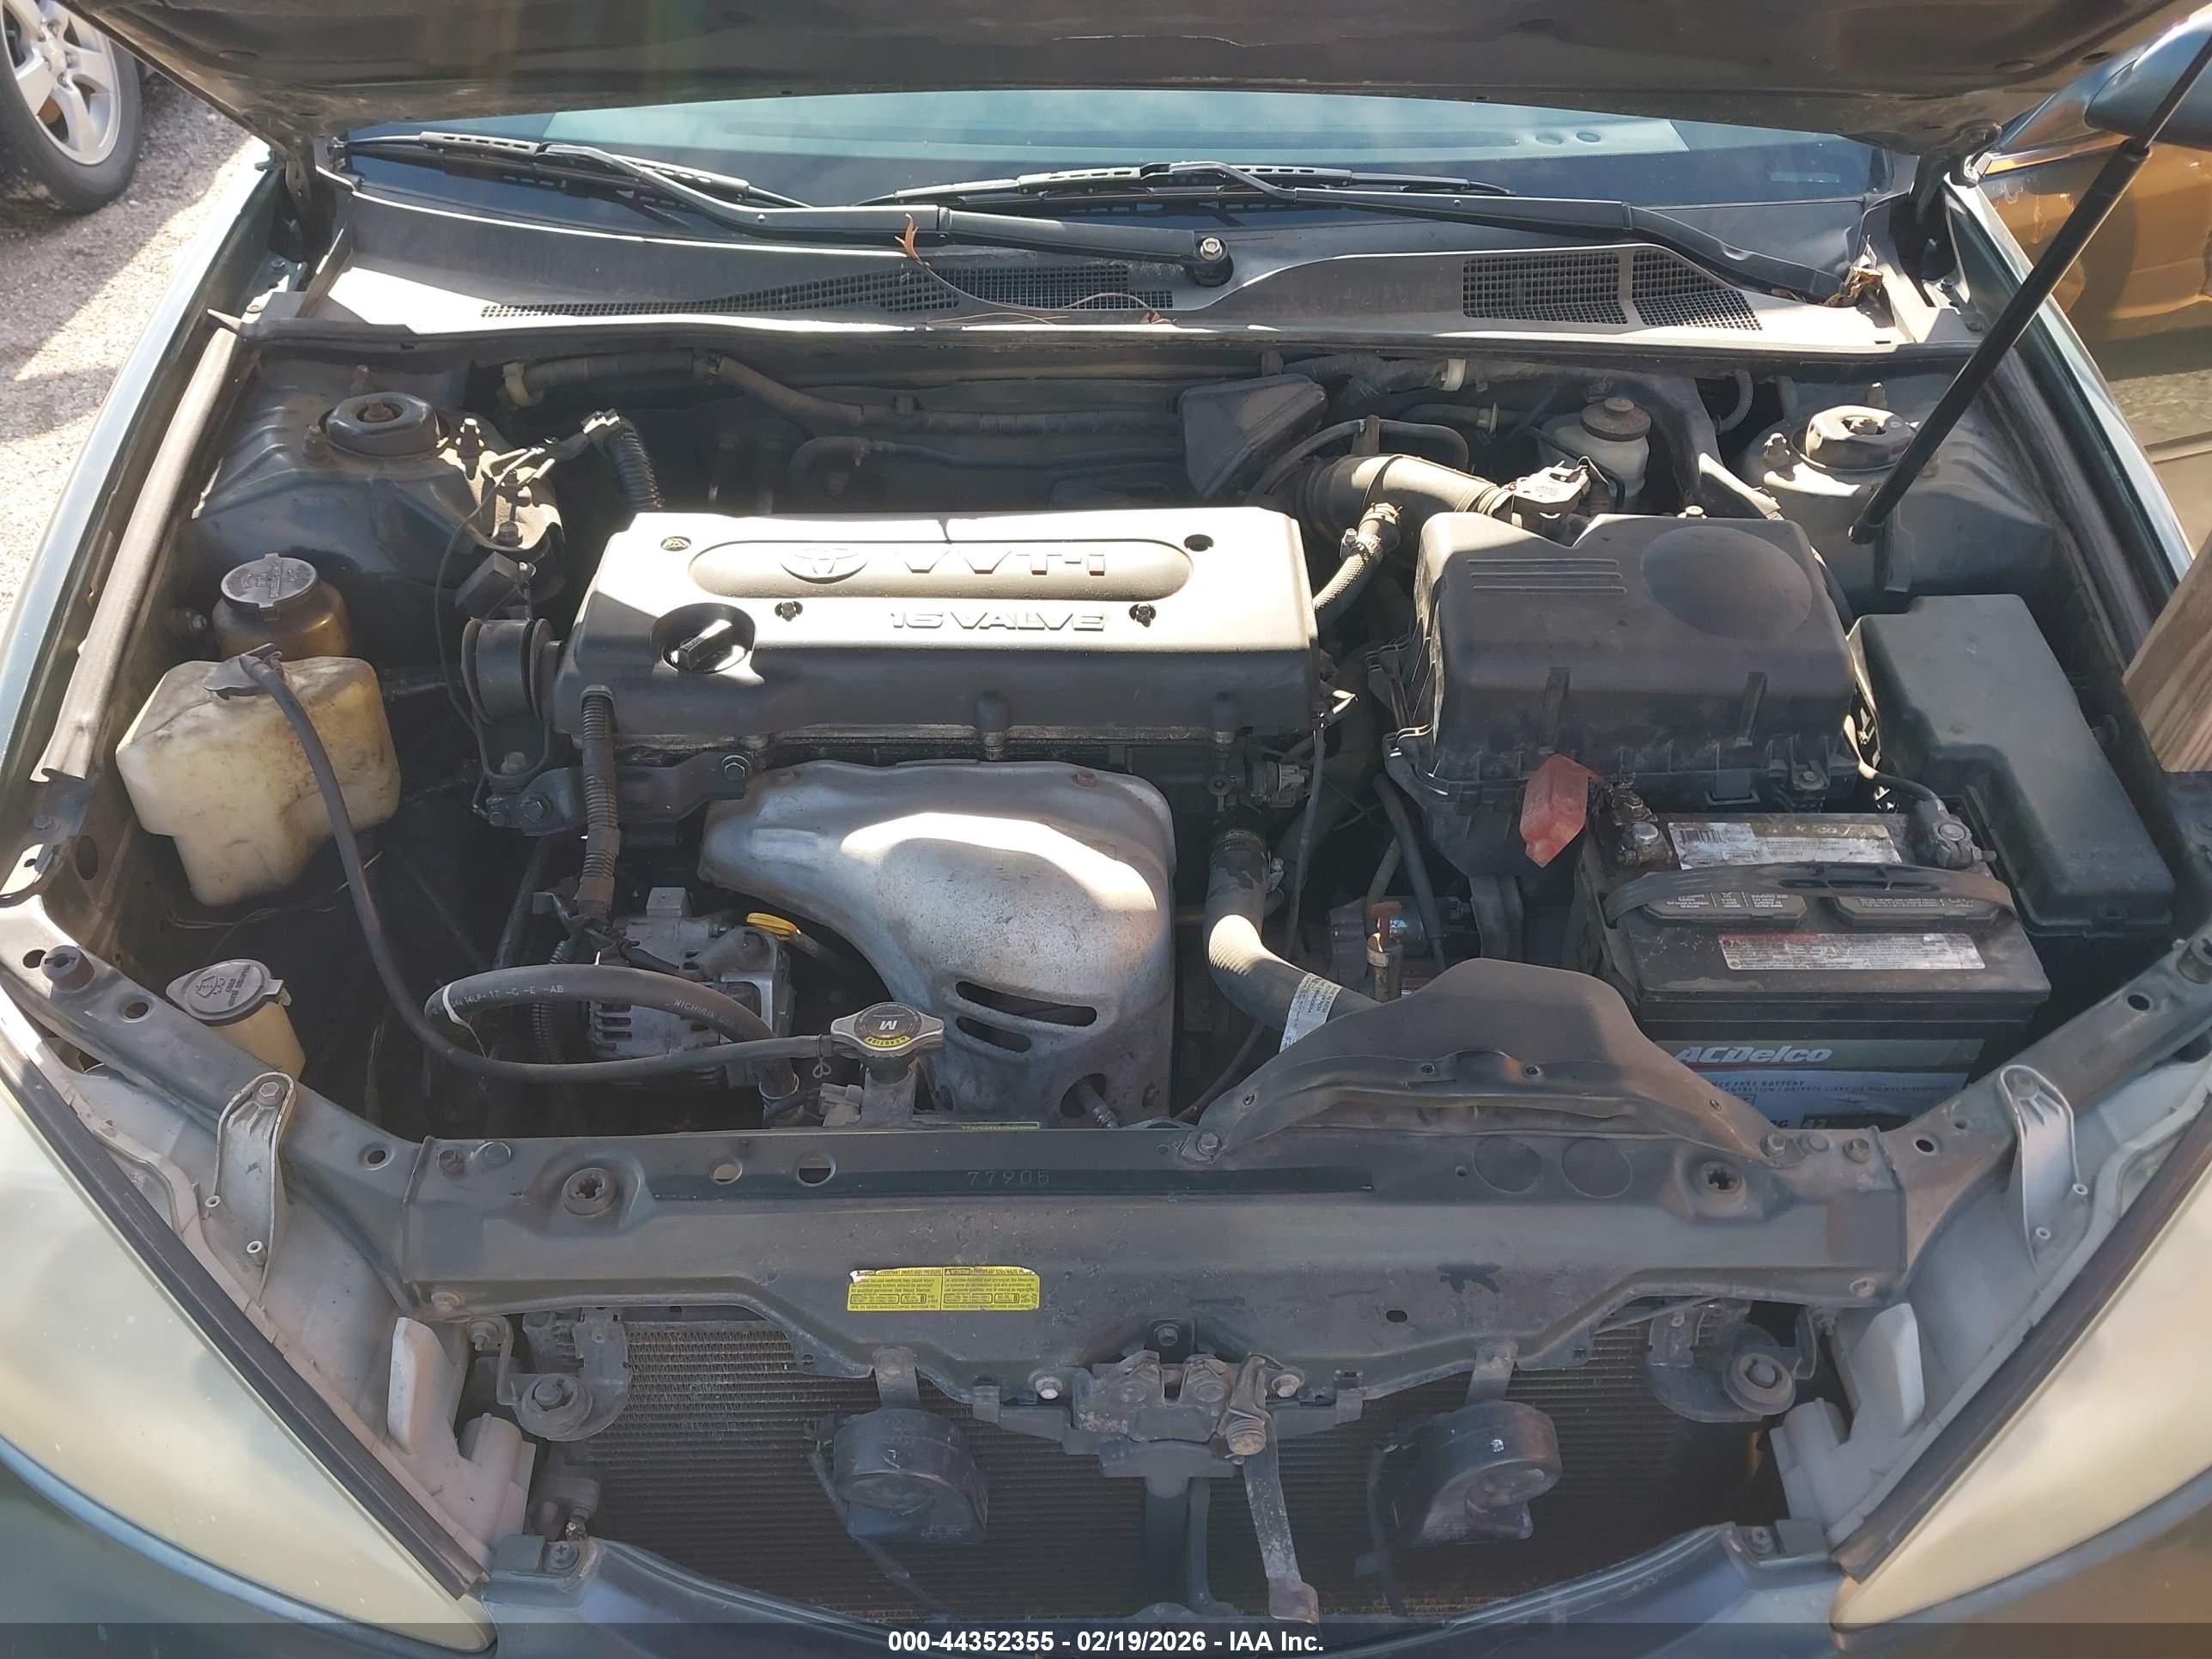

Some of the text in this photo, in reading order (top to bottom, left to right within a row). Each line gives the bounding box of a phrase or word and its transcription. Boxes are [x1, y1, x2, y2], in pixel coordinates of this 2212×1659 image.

[890, 611, 1105, 632] 16 VALVE
[867, 1037, 901, 1046] CAUTION
[1675, 1046, 1832, 1063] ACDelco
[967, 1170, 1051, 1187] 77905
